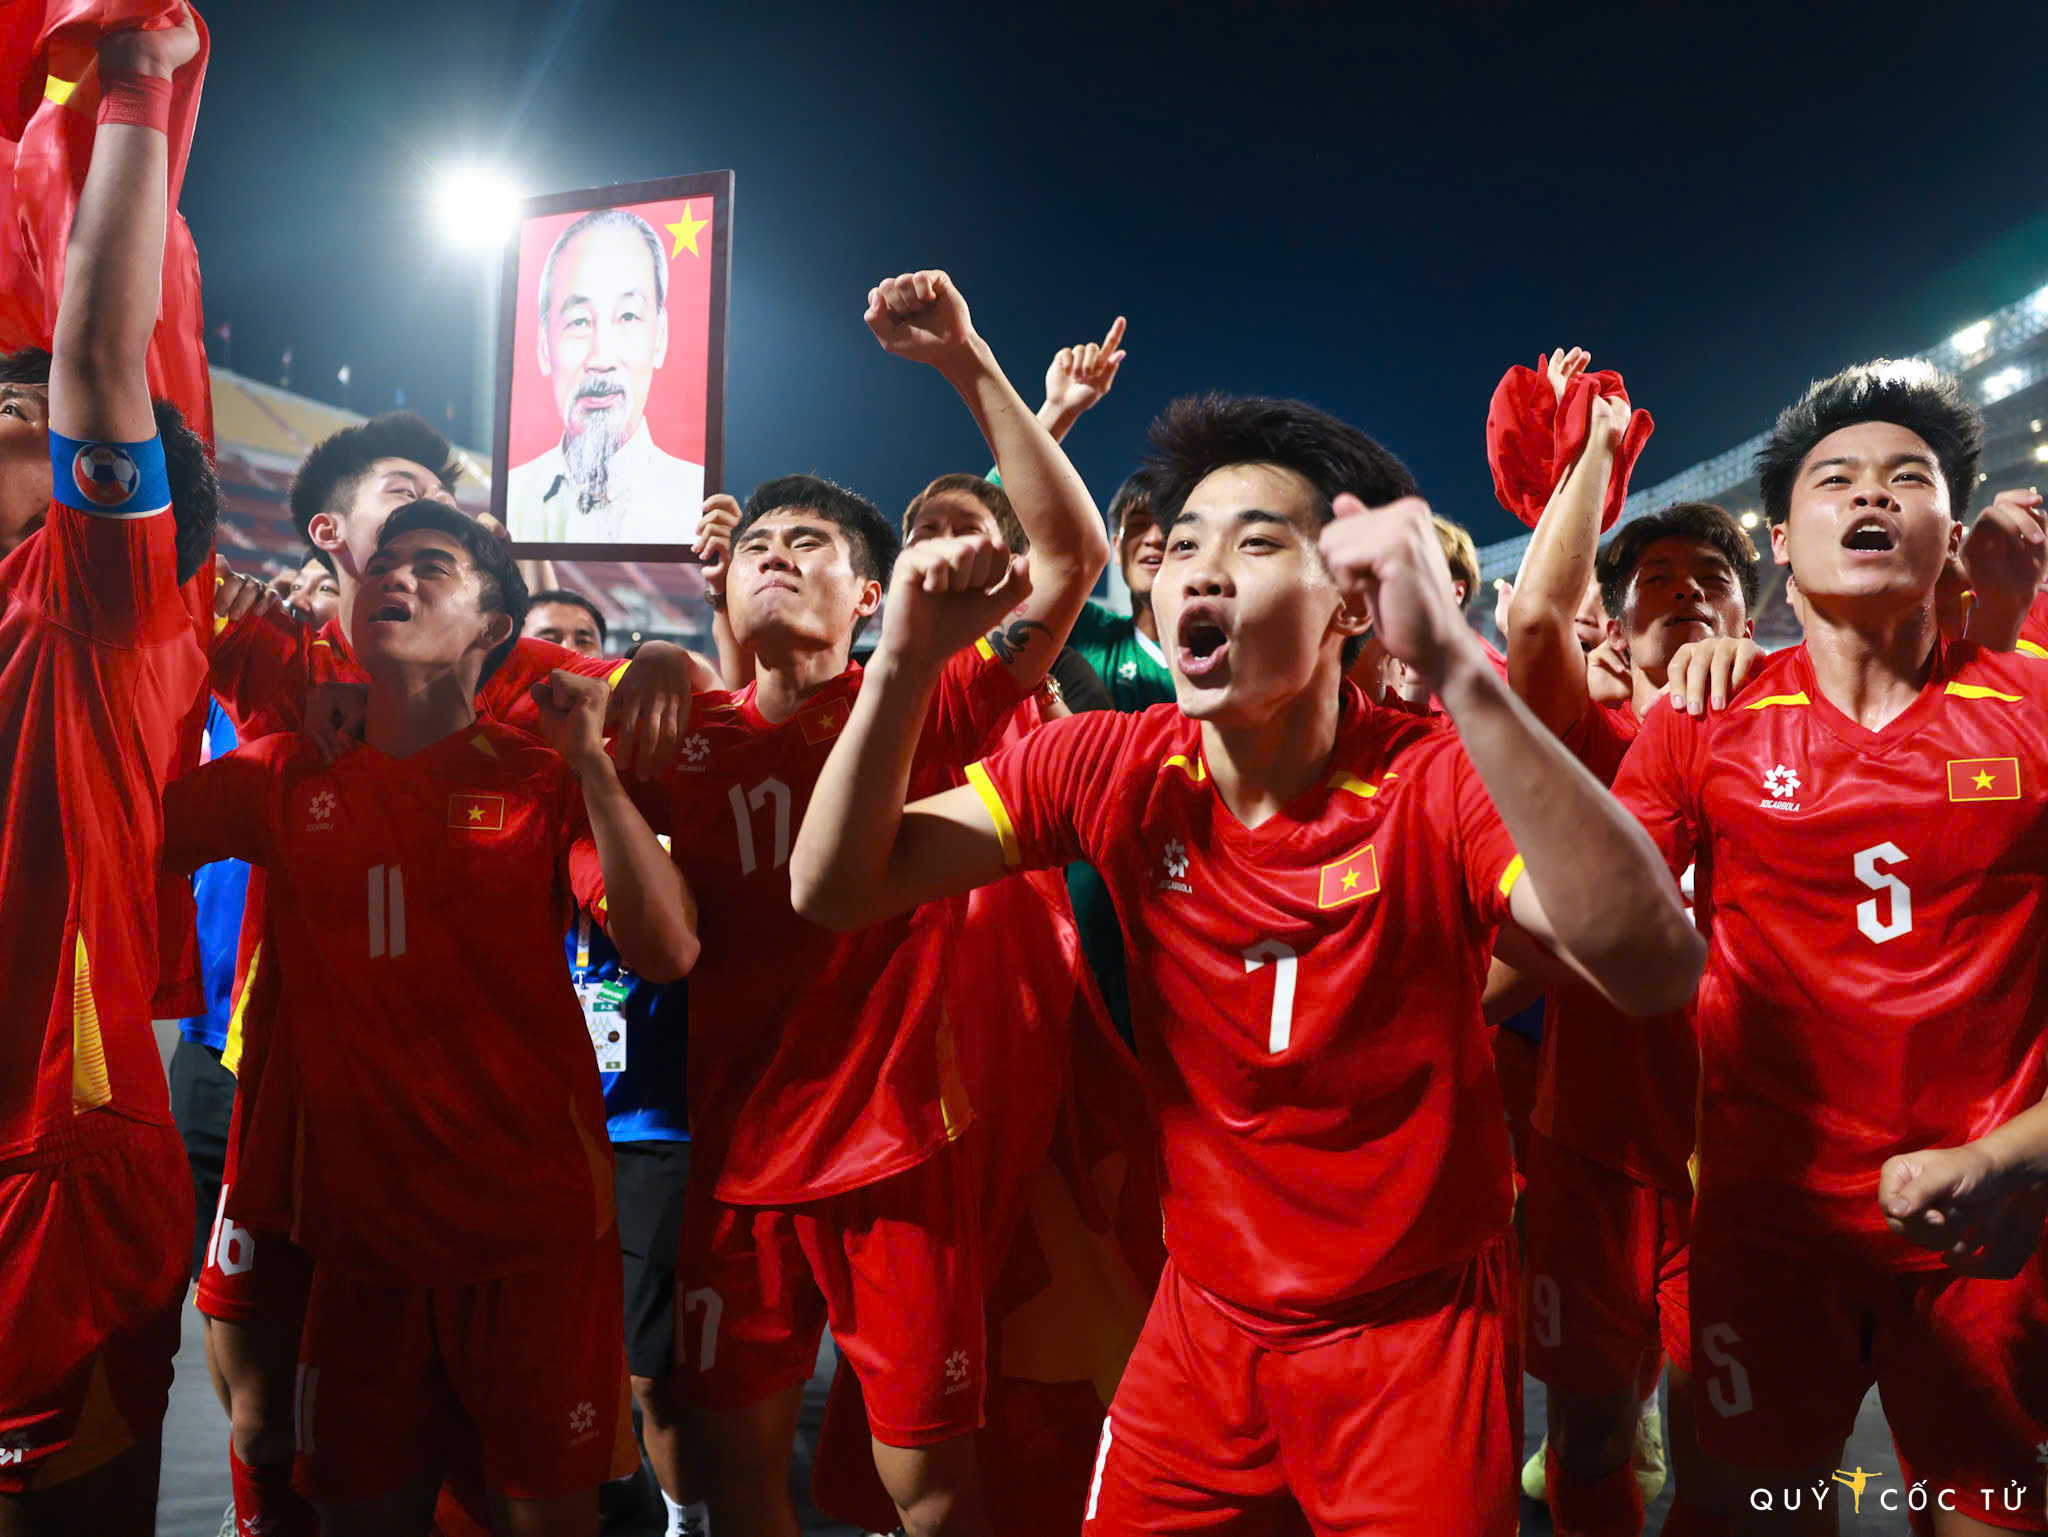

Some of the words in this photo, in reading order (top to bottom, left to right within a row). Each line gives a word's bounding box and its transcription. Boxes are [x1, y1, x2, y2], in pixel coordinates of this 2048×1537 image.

[727, 776, 791, 877] 17
[1759, 799, 1801, 812] JOGARBOLA
[367, 863, 407, 960] 11
[1853, 841, 1913, 944] 5
[1241, 938, 1298, 1055] 7
[207, 1183, 255, 1277] 16
